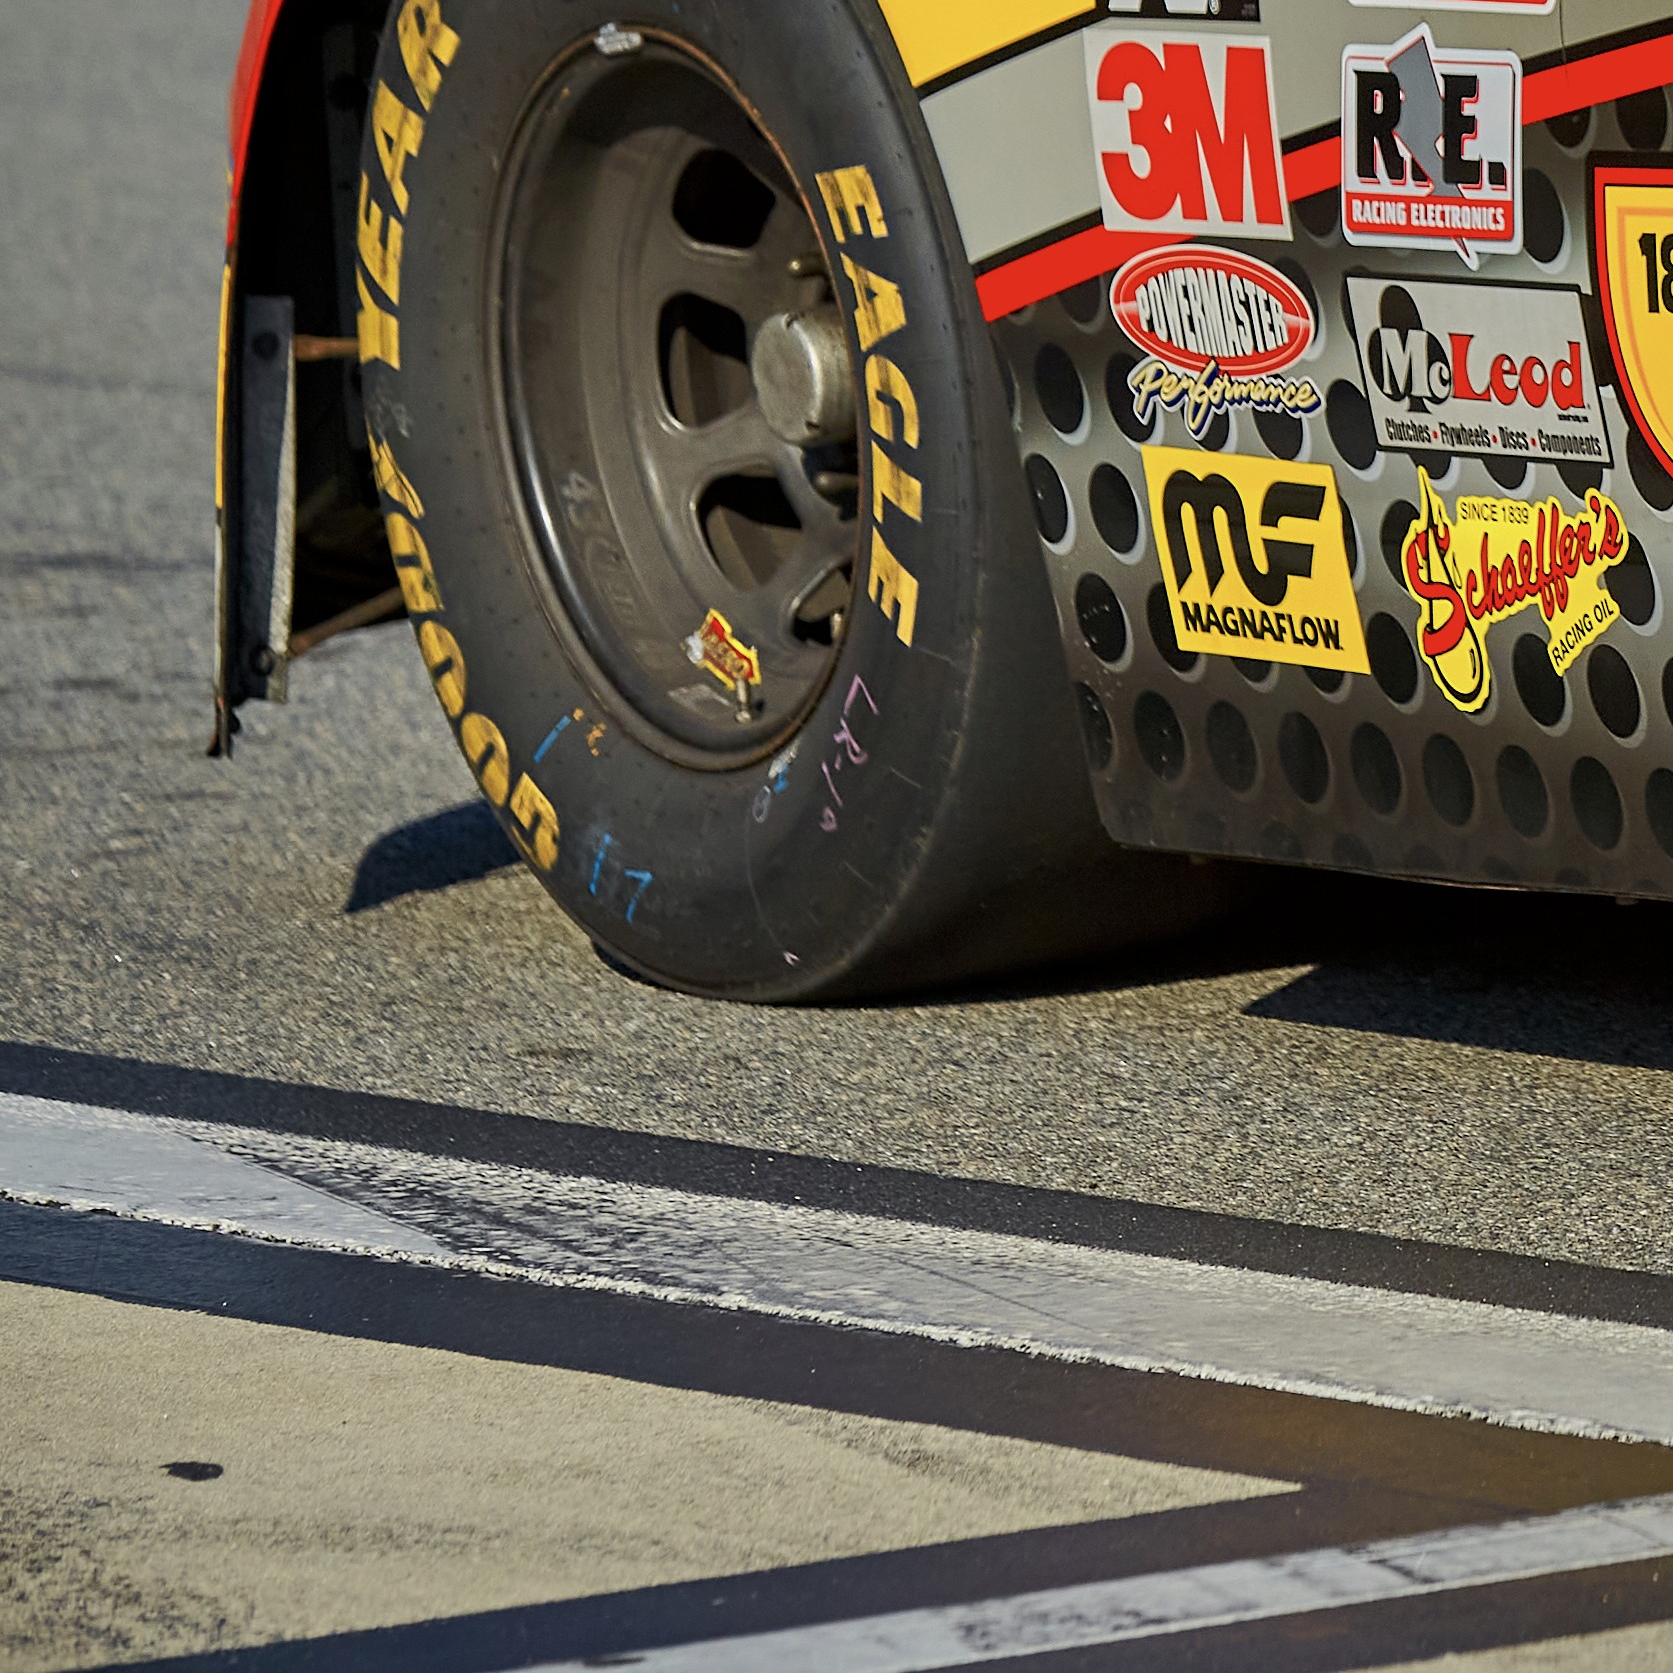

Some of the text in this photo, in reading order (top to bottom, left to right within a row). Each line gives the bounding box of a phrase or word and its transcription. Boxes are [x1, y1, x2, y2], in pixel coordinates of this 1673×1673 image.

[1096, 40, 1285, 226] 3M
[1351, 198, 1506, 232] RACING ELECTRONICS
[1134, 266, 1290, 358] POWERMASTER
[814, 163, 924, 648] EAGLE
[1131, 358, 1322, 437] Performance
[1378, 327, 1586, 411] McLeod
[1384, 417, 1603, 457] Clutches Flywheels Discs Components
[1459, 501, 1530, 525] SINCE 1839
[1406, 494, 1624, 658] Schaeffer's
[1178, 599, 1342, 651] MAGNAFLOW
[1551, 597, 1616, 668] RACING OIL
